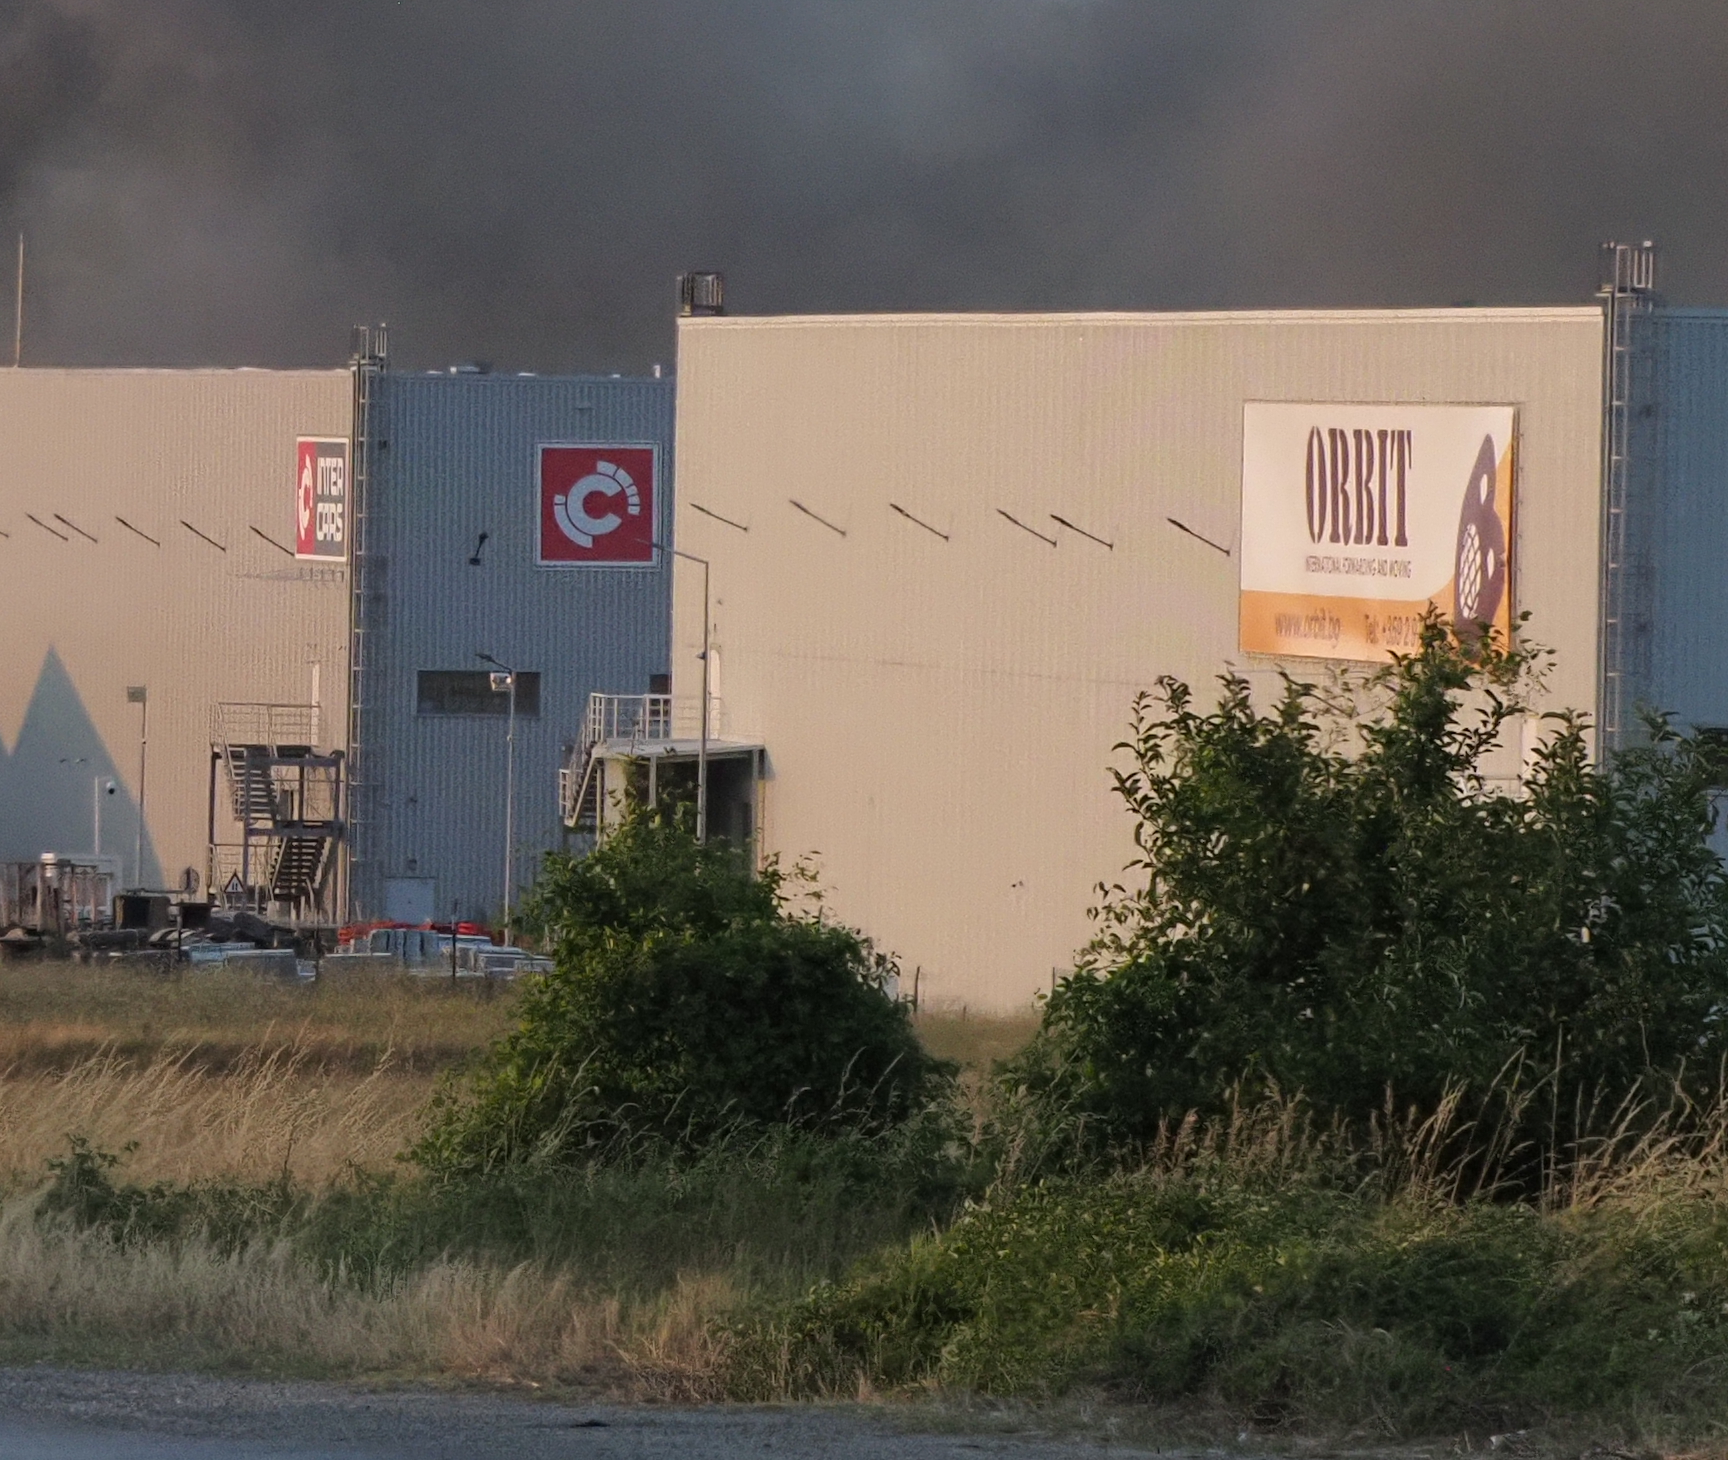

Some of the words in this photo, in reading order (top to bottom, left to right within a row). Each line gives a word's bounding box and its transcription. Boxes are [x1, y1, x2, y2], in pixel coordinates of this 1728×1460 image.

[317, 457, 344, 496] INTER
[1305, 425, 1413, 548] ORBIT
[316, 502, 343, 542] CARS
[1377, 558, 1388, 577] AND
[1389, 559, 1412, 579] MOVING
[1275, 608, 1341, 649] www.orbit.bg
